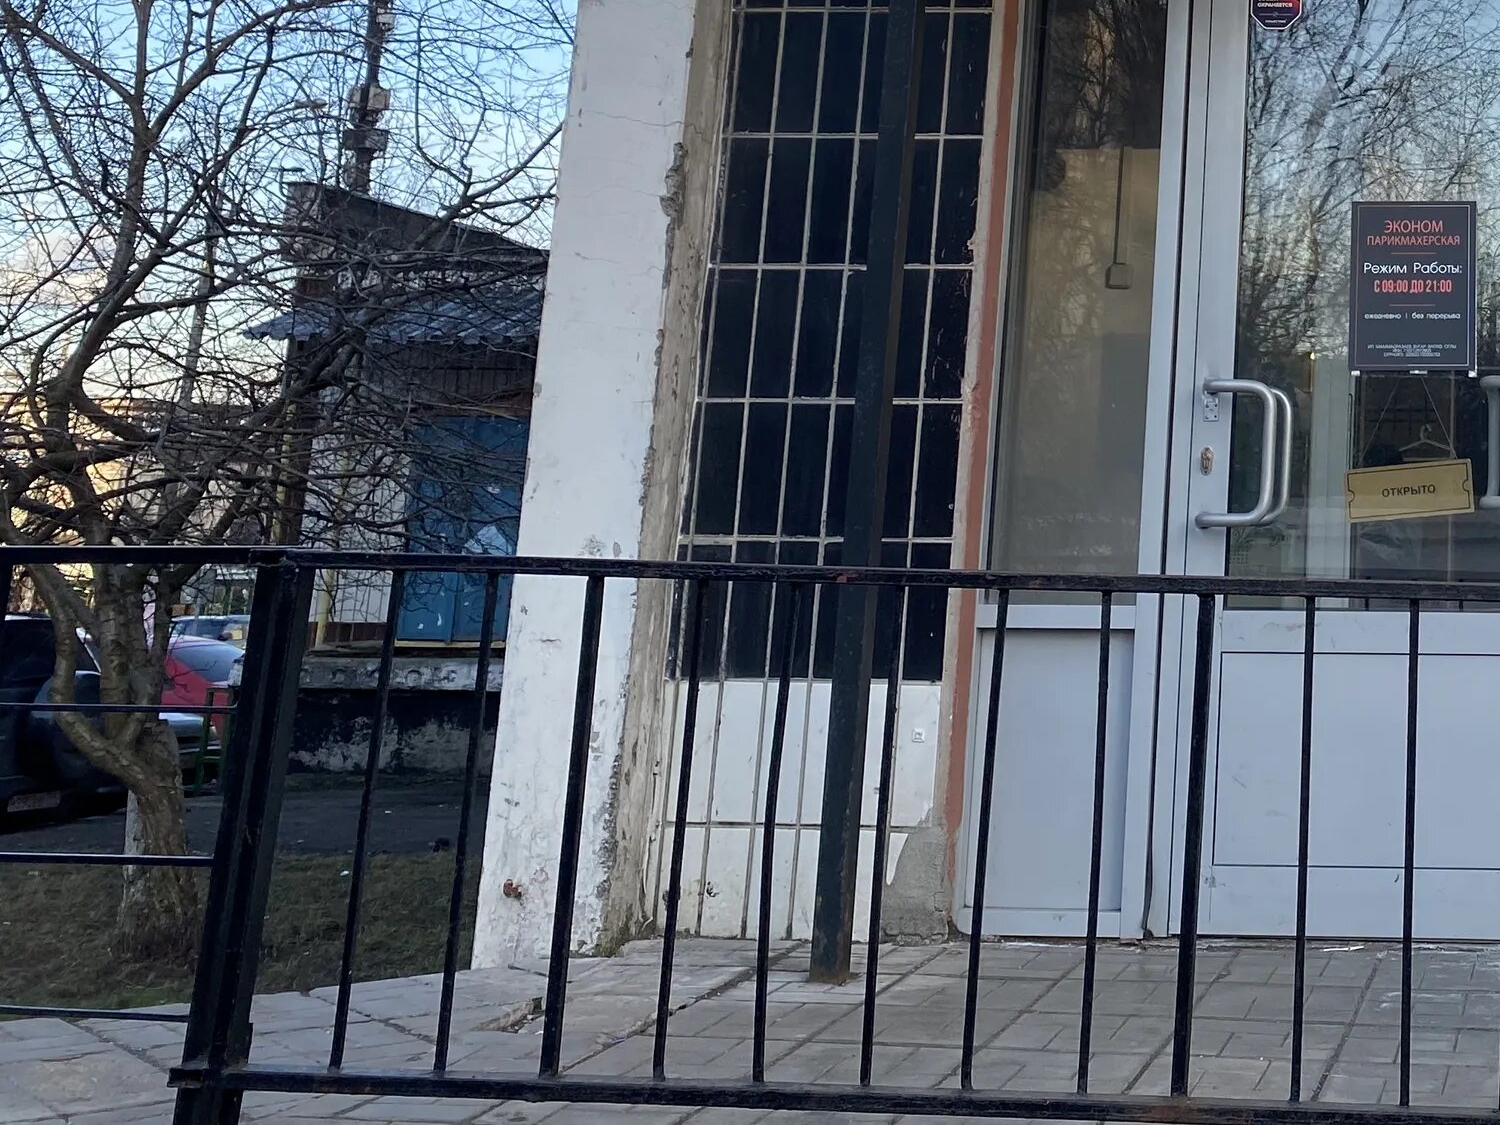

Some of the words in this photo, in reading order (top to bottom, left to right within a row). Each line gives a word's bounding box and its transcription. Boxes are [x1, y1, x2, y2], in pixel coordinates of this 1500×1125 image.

[1384, 220, 1444, 233] ЭКОНОМ
[1367, 235, 1461, 246] ПАРИКМАХЕРСКАЯ
[1363, 262, 1408, 274] Режим
[1413, 261, 1463, 274] Работы:
[1374, 279, 1381, 293] С
[1381, 279, 1409, 293] 09:00
[1409, 279, 1424, 293] ДО
[1425, 279, 1452, 293] 21:00
[1411, 311, 1425, 319] без
[1381, 484, 1436, 498] ОТКРЫТО
